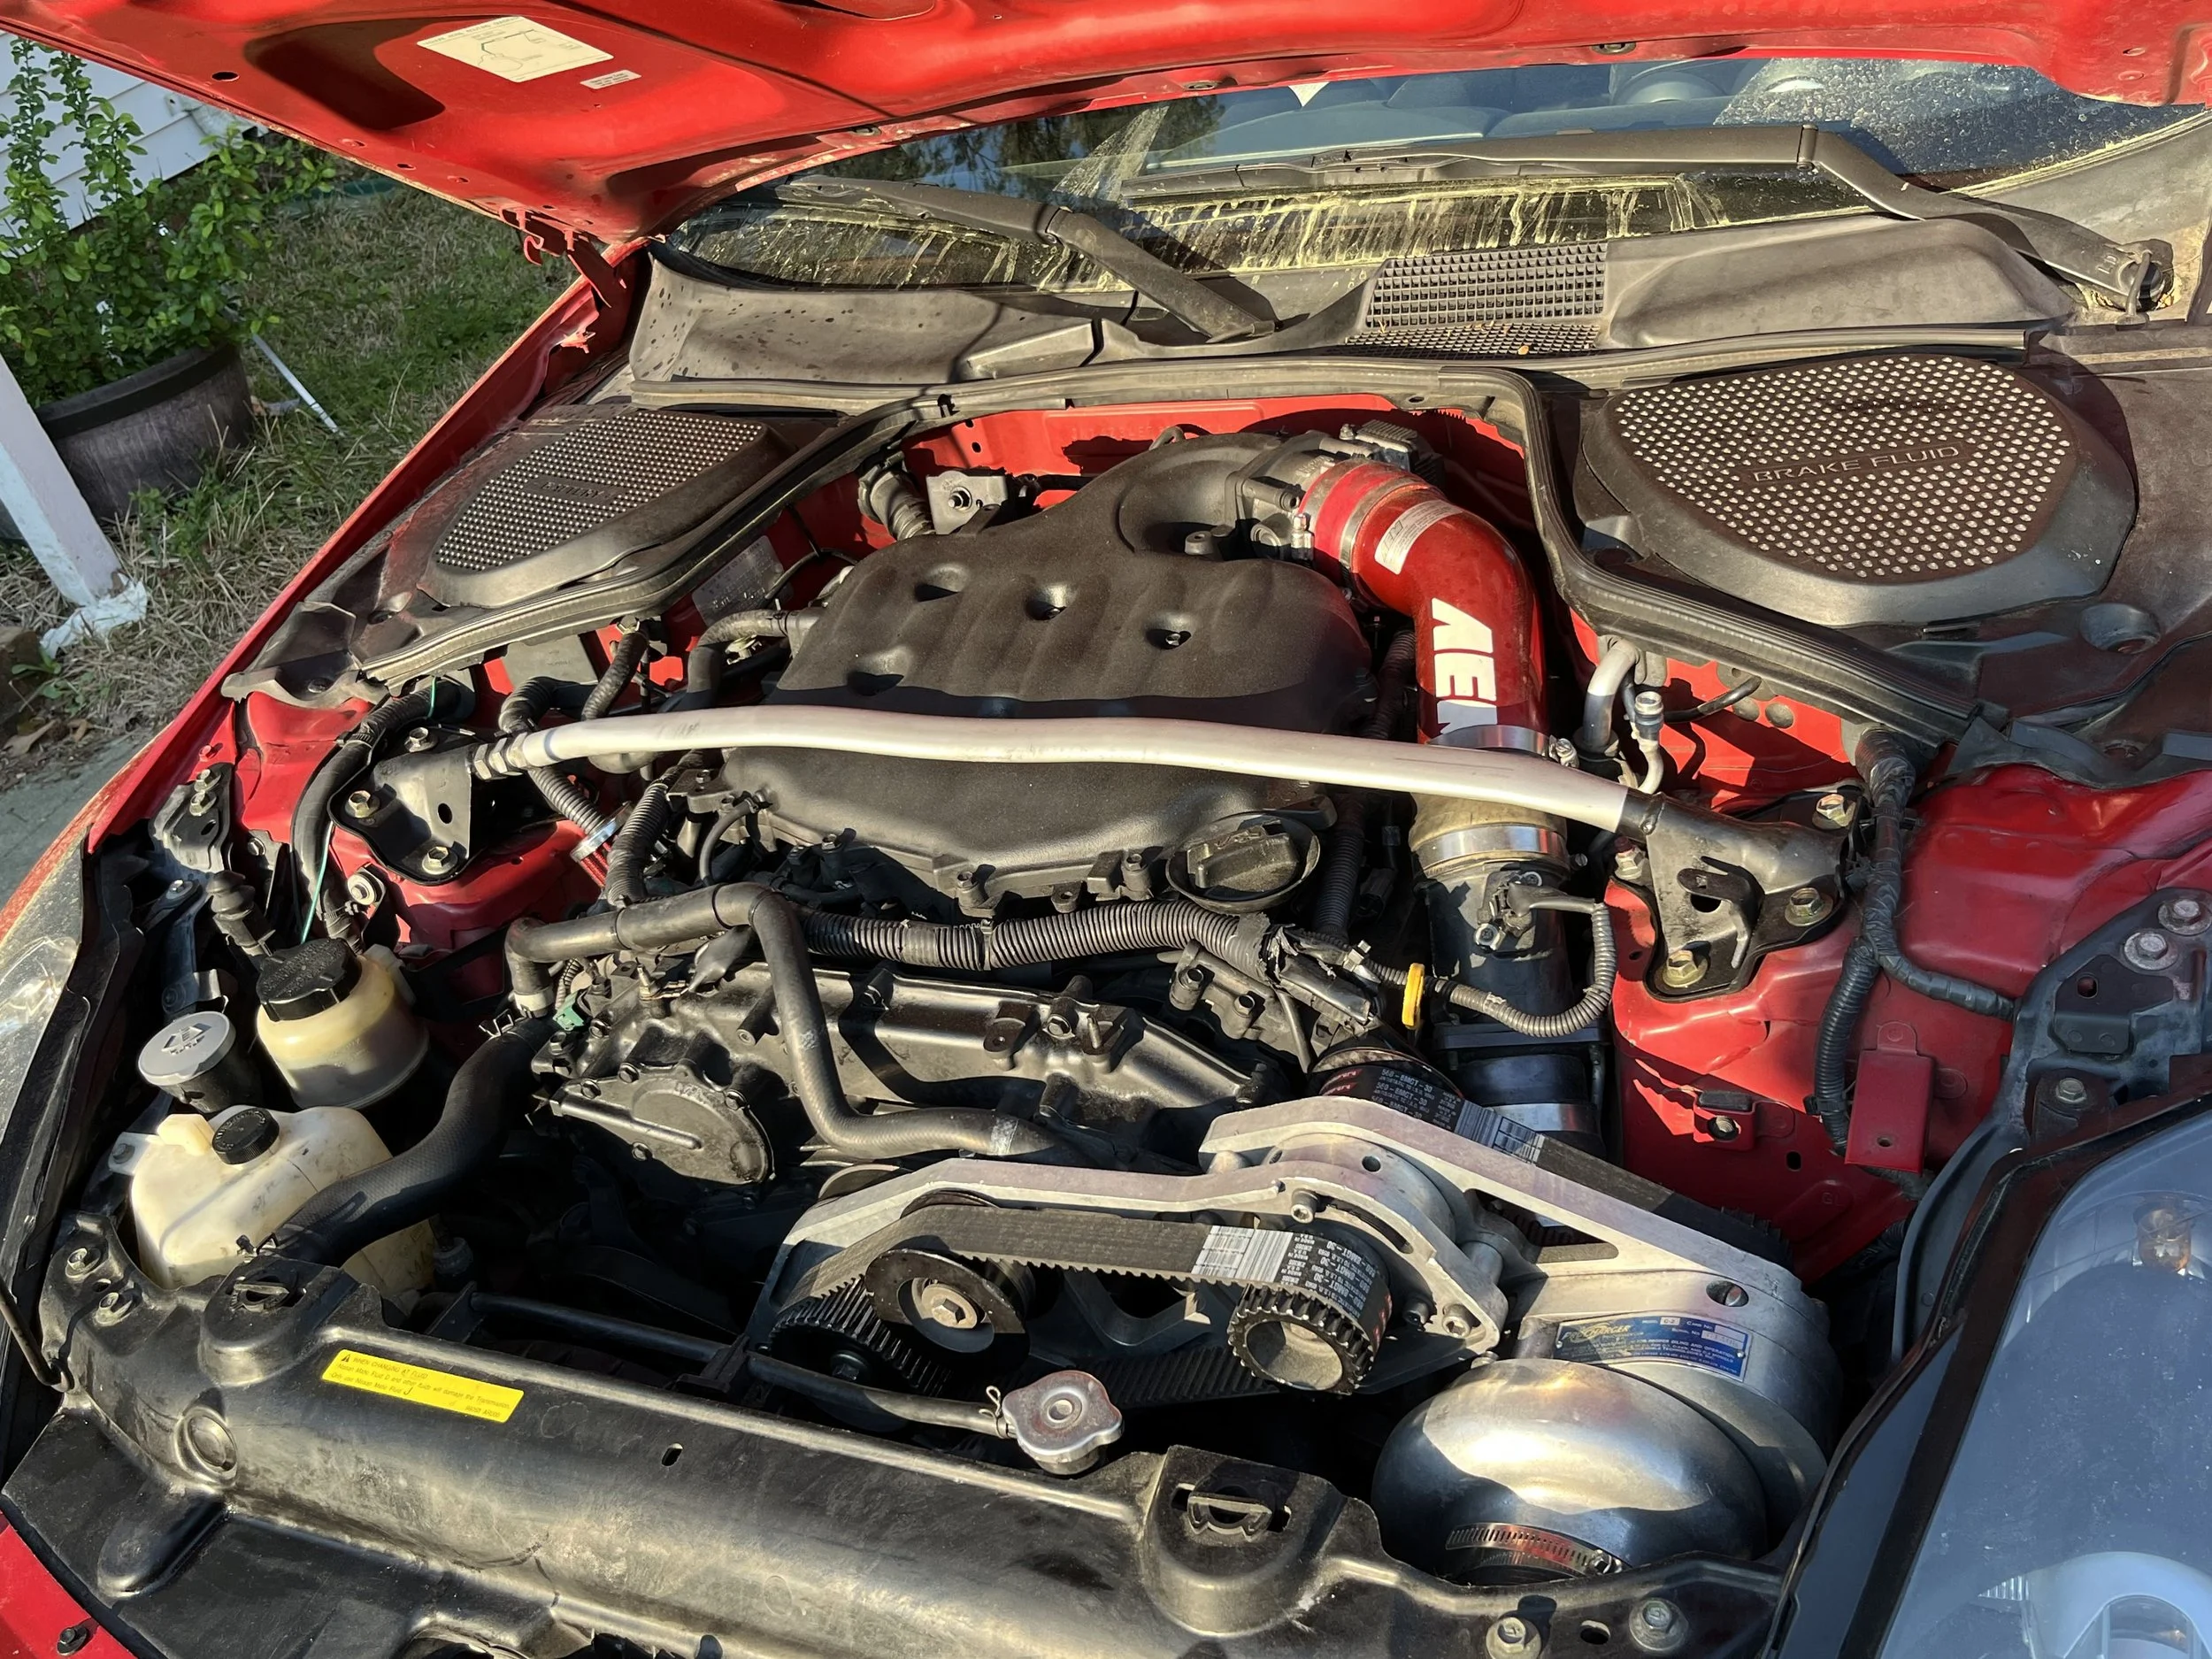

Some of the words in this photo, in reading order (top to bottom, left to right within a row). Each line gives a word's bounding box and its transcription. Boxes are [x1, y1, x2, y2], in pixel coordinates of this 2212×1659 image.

[1753, 459, 1861, 481] BRAKE
[1870, 446, 1959, 467] FLUID
[352, 1356, 370, 1366] WHEN
[371, 1360, 400, 1372] CHANGING
[403, 1386, 412, 1396] J
